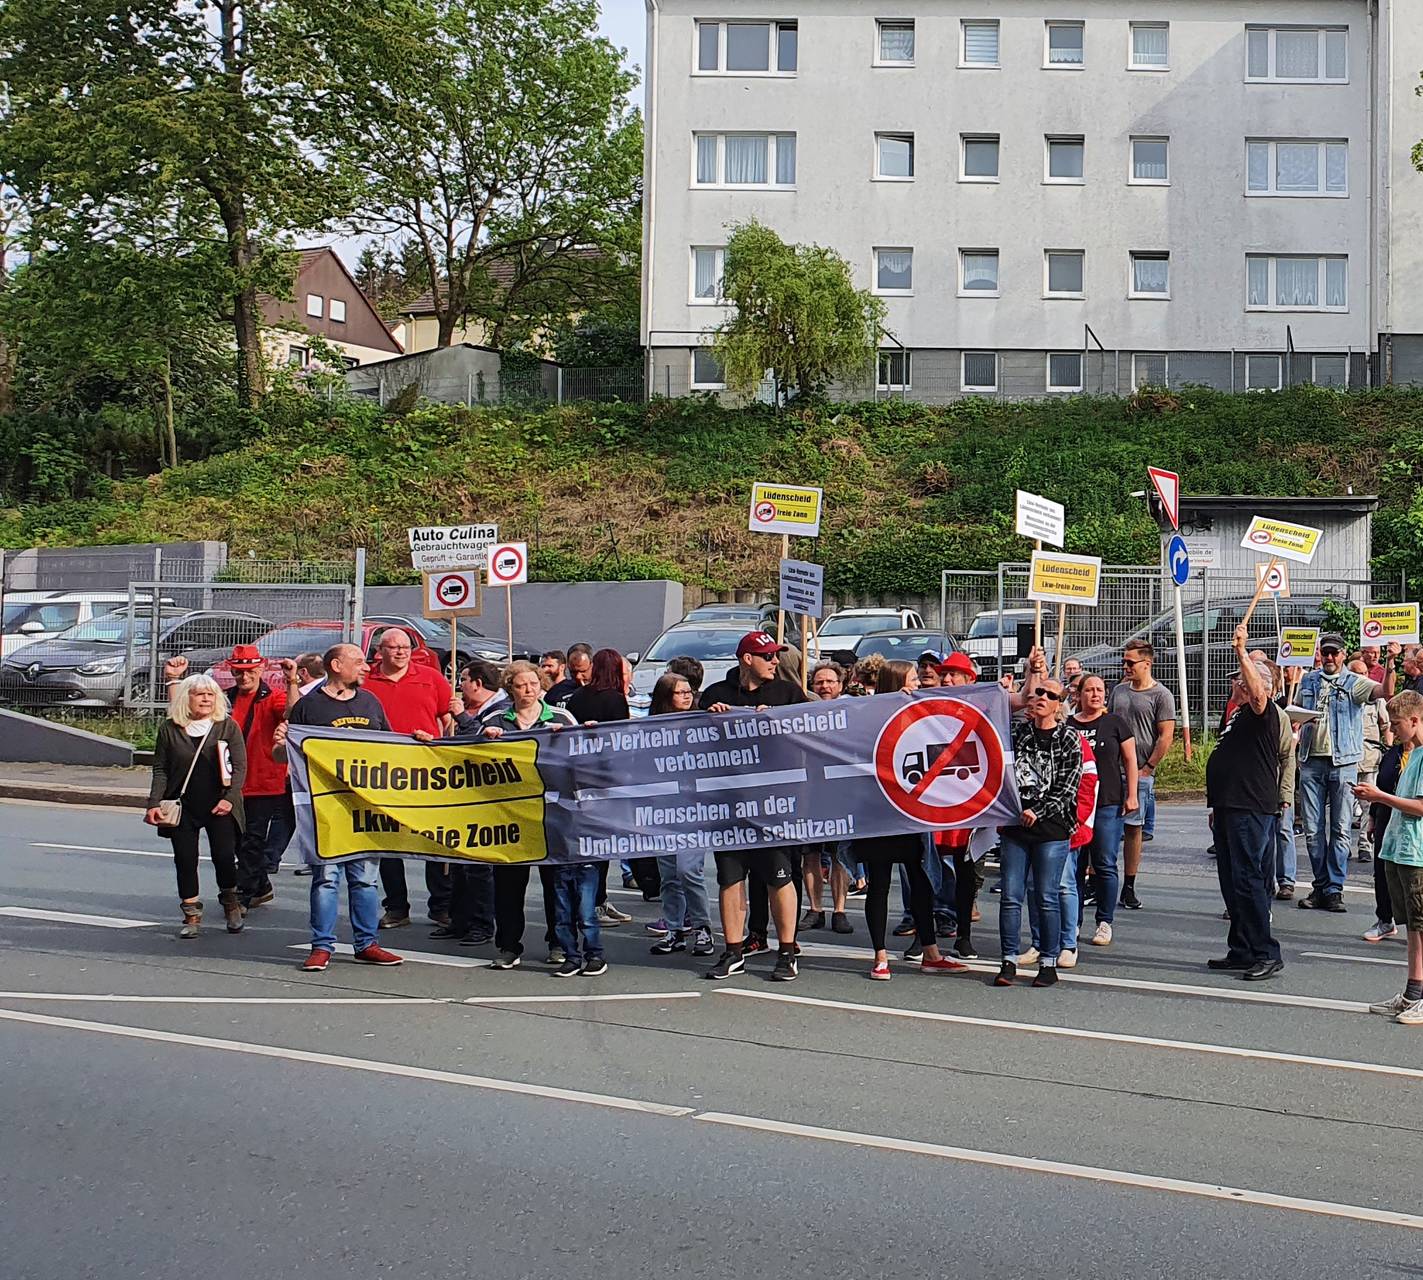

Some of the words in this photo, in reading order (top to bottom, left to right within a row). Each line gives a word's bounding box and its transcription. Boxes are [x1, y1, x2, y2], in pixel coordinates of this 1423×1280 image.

[763, 490, 812, 504] Lüdenscheid
[412, 528, 444, 542] Auto
[449, 526, 495, 540] Culina
[1261, 522, 1311, 539] Lüdenscheid
[1042, 563, 1090, 577] Lüdenscheid
[1369, 609, 1411, 619] Lüdenscheid
[568, 730, 682, 757] Lkw-Verkehr
[686, 725, 720, 743] aus
[723, 709, 848, 741] Lüdenscheid
[654, 744, 761, 774] verbannen!
[335, 757, 523, 791] Lüdenscheid
[635, 802, 731, 827] Menschen
[735, 801, 761, 819] an
[764, 794, 797, 816] der
[466, 822, 521, 849] Zone
[579, 826, 758, 857] Umleitungsstrecke
[762, 814, 855, 843] schützen!
